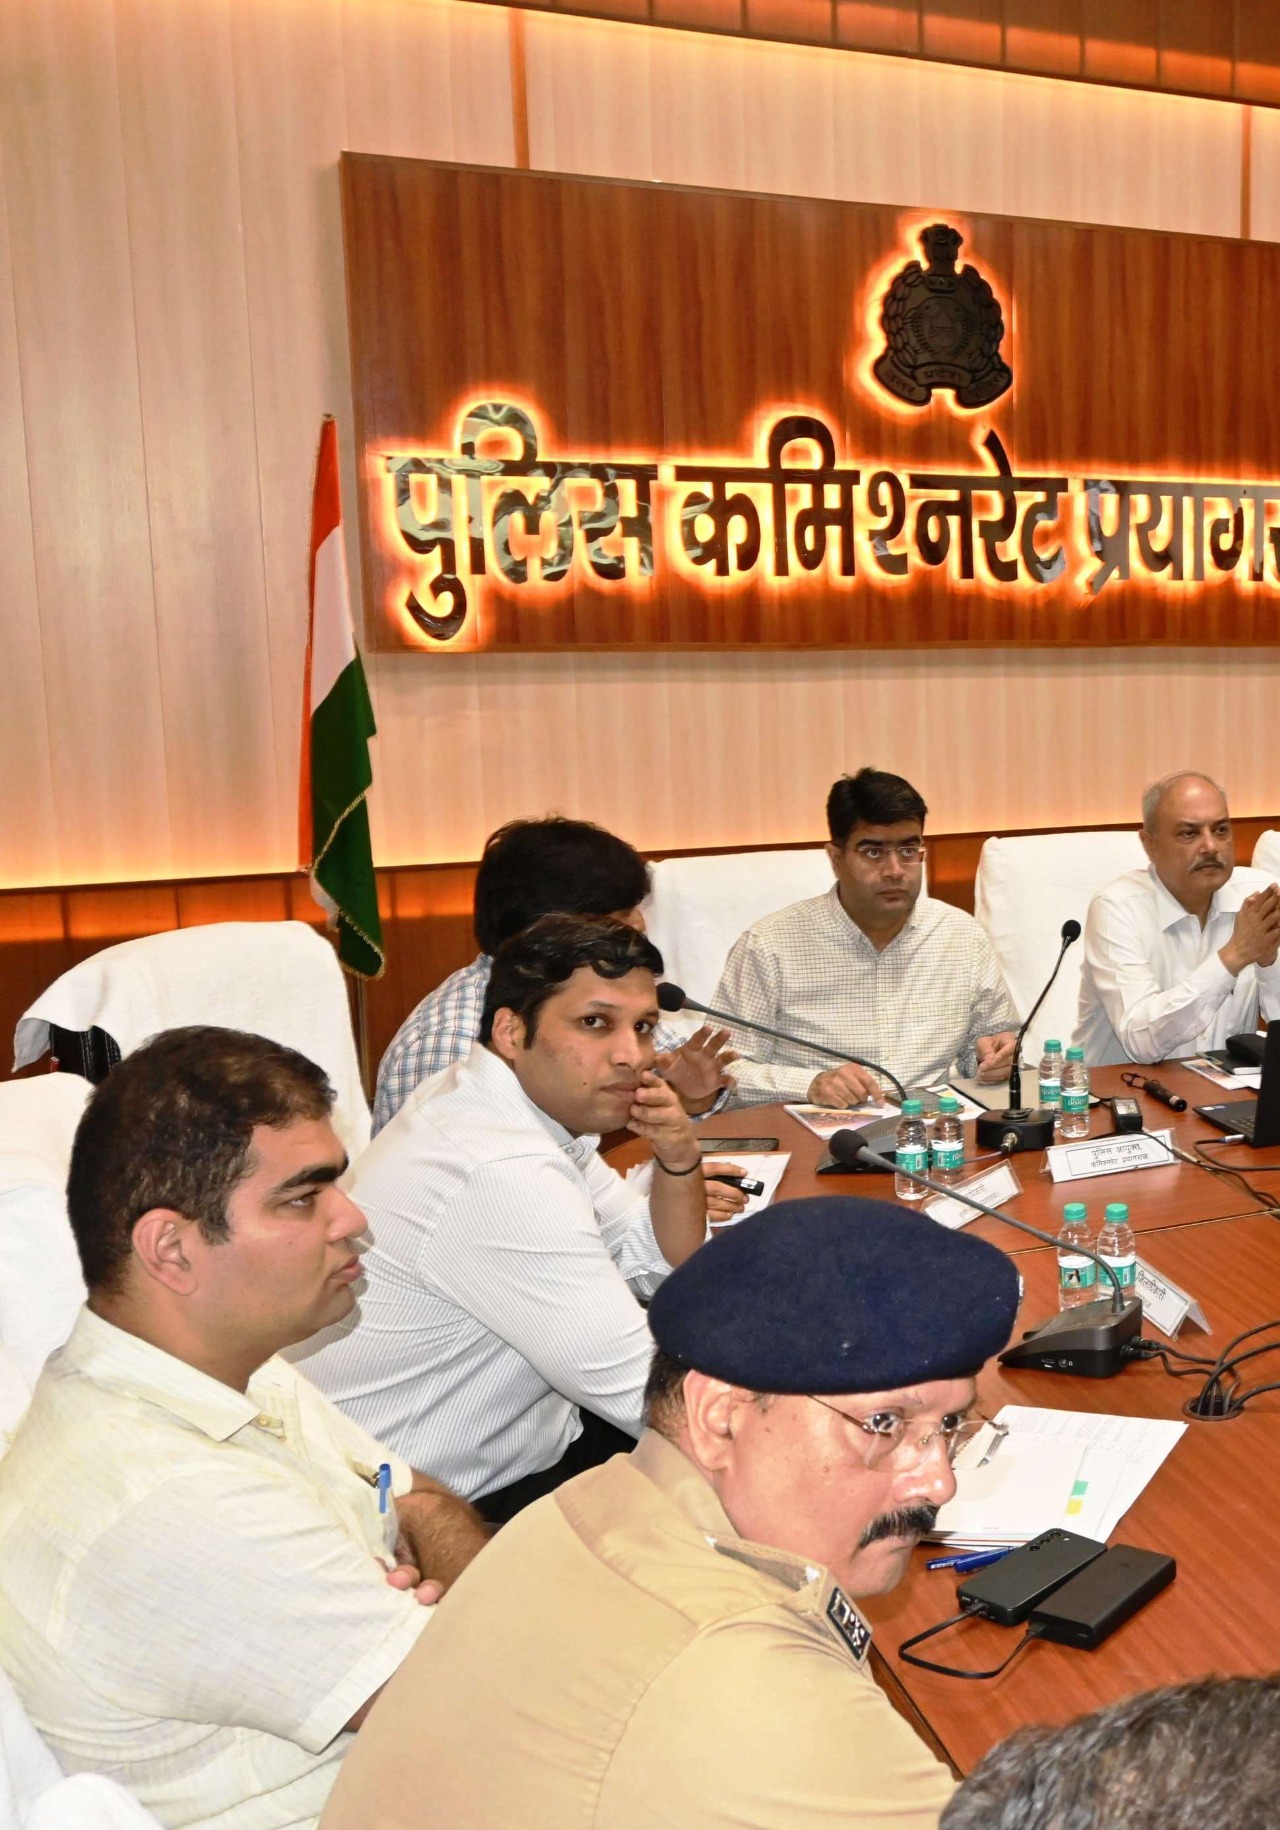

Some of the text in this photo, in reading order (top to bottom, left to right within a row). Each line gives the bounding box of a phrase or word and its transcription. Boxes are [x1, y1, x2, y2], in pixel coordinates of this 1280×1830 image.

[385, 402, 658, 642] पुलिस
[673, 414, 1070, 581] कमिश्नरेट
[1091, 1147, 1112, 1160] पुलिस
[1121, 1153, 1148, 1163] प्रयागराज
